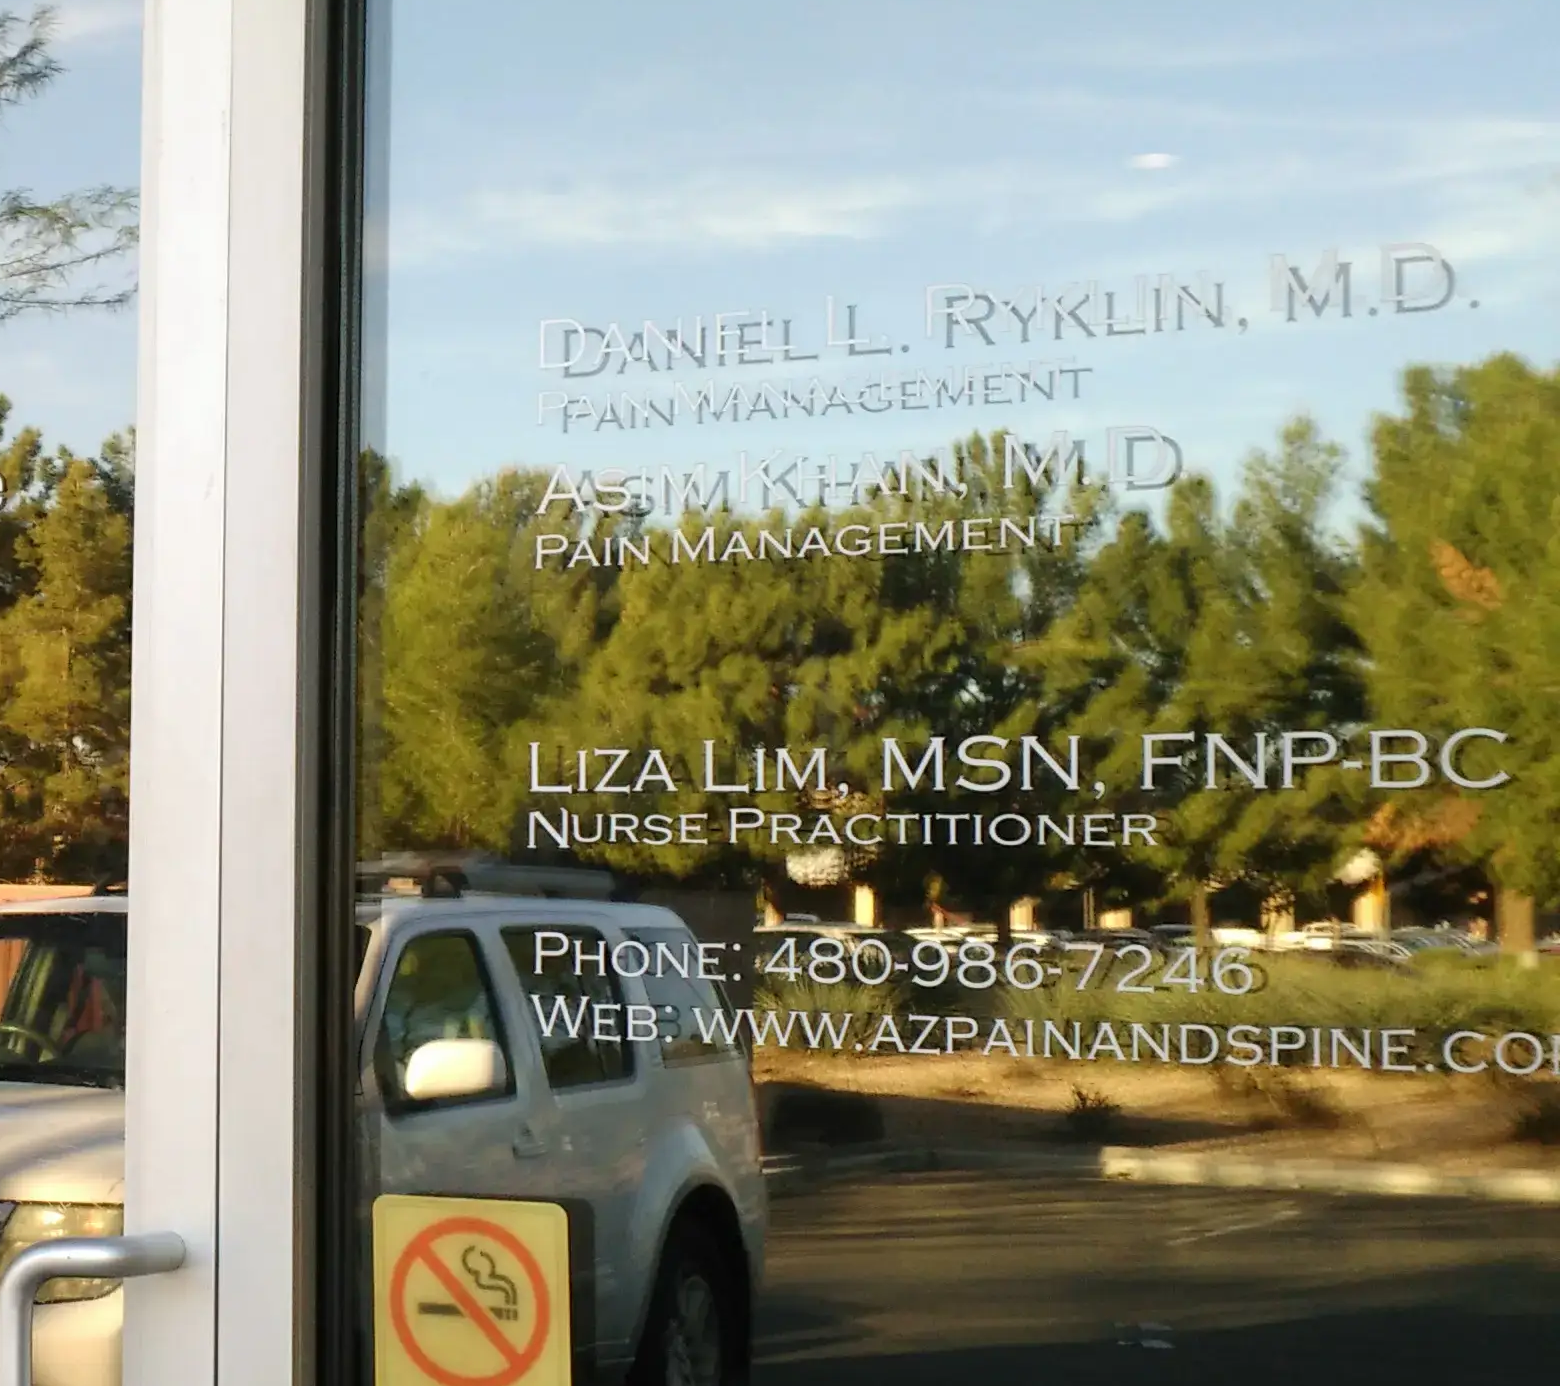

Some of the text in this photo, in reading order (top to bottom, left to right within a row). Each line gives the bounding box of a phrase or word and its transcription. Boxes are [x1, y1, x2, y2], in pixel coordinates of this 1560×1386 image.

[539, 310, 819, 378] DANIEL
[1269, 243, 1480, 322] M.D.
[536, 357, 1093, 432] PAIN MANAGEMENT
[536, 462, 712, 515] ASIM
[535, 514, 1076, 570] PAIN MANAGEMENT
[527, 727, 1511, 801] LIZA LIM, MSN, FNP-BC
[526, 808, 1160, 850] NURSE PRACTITIONER
[533, 931, 1255, 995] PHONE: 480-986-7246
[529, 993, 674, 1044] WEB:
